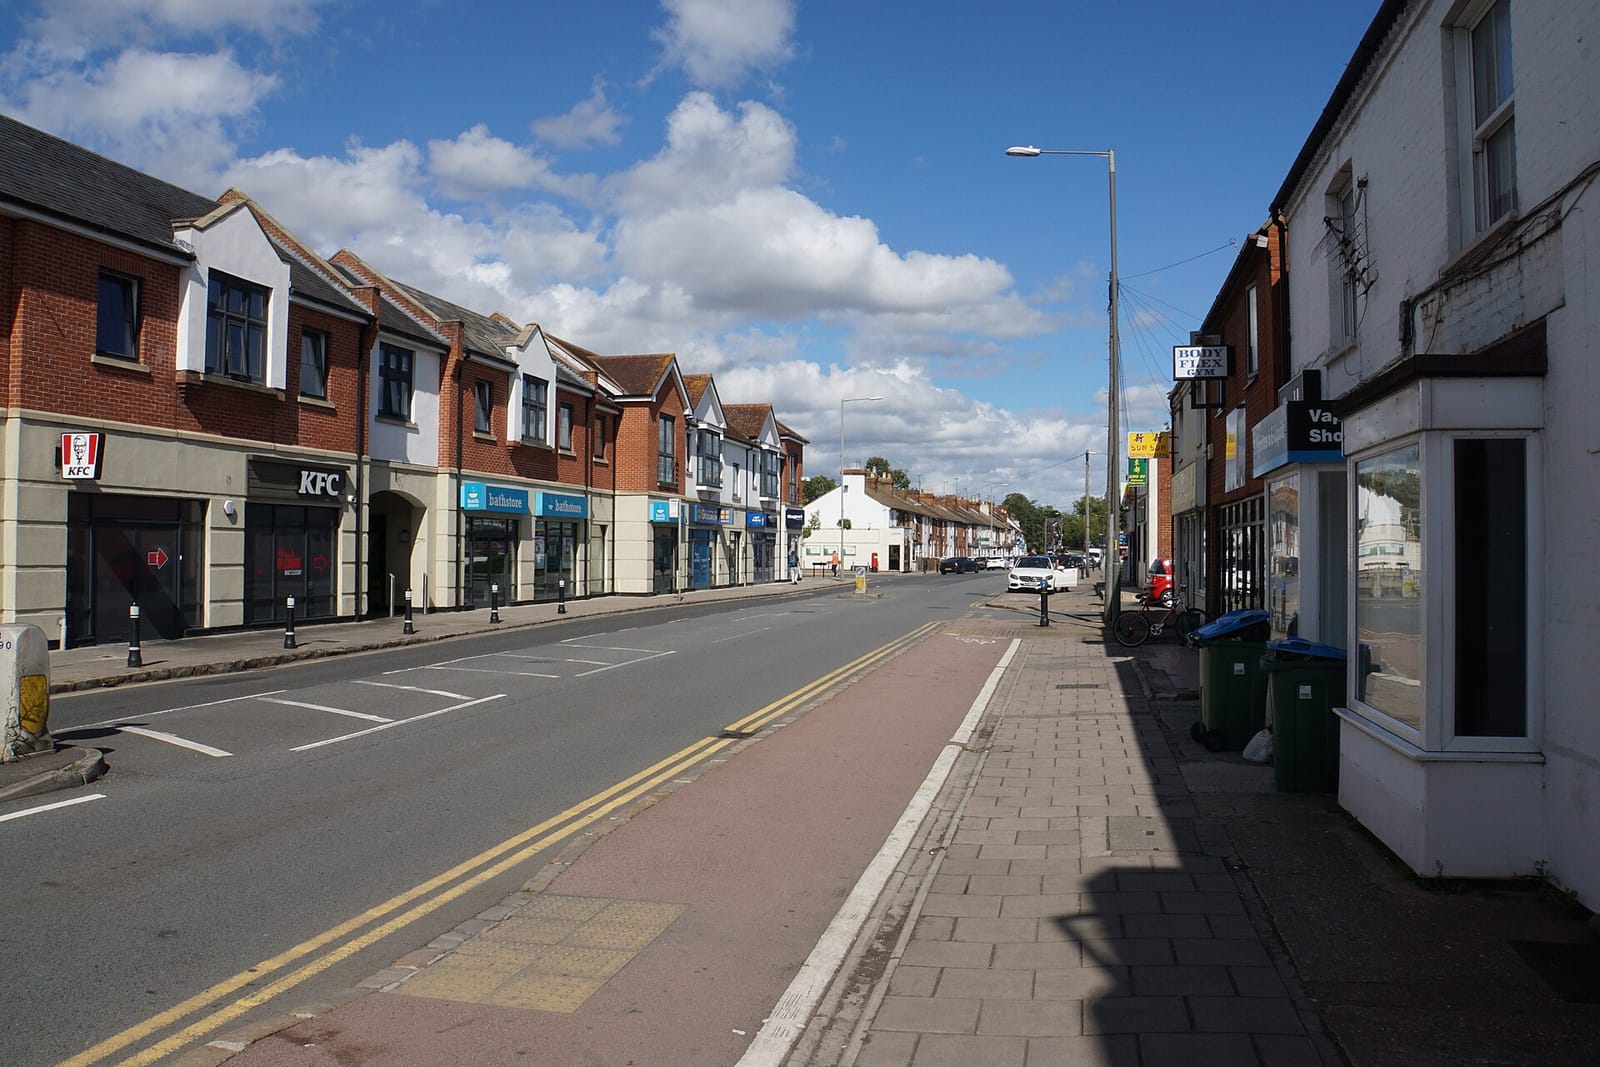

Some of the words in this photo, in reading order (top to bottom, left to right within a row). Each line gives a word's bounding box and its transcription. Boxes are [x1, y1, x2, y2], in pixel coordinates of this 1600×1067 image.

[1179, 349, 1224, 358] BODY
[1179, 359, 1224, 368] FLEX
[1187, 368, 1216, 376] GYM
[68, 466, 90, 476] KFC
[298, 470, 340, 497] KFC
[488, 492, 523, 508] bathstore
[555, 499, 582, 513] bathstore
